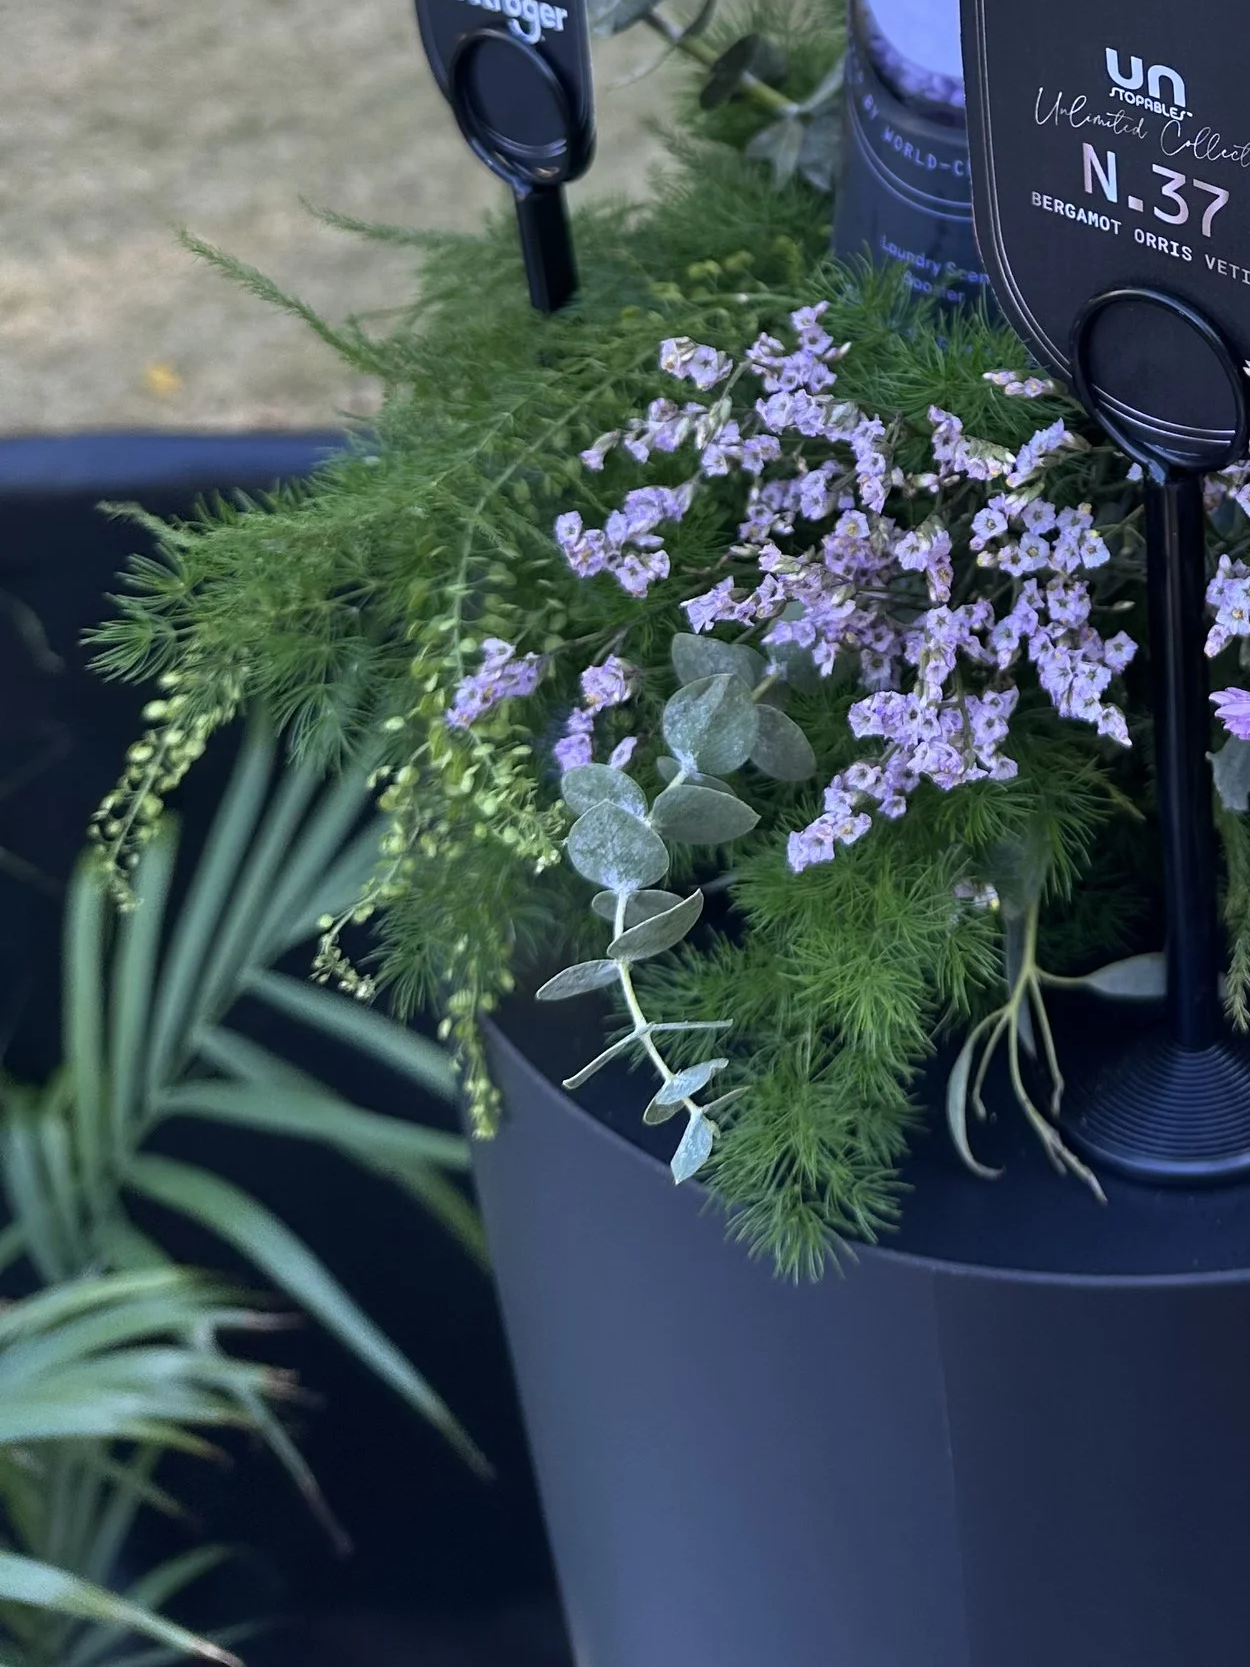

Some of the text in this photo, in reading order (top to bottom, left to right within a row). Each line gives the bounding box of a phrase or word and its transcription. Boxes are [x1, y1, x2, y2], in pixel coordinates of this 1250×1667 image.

[1034, 87, 1149, 139] Unlimited
[882, 126, 970, 177] WORLD-C
[1082, 142, 1230, 238] N.37
[1031, 191, 1122, 235] BERGAMOT
[1134, 228, 1193, 262] ORRIS
[880, 234, 941, 277] Laundry
